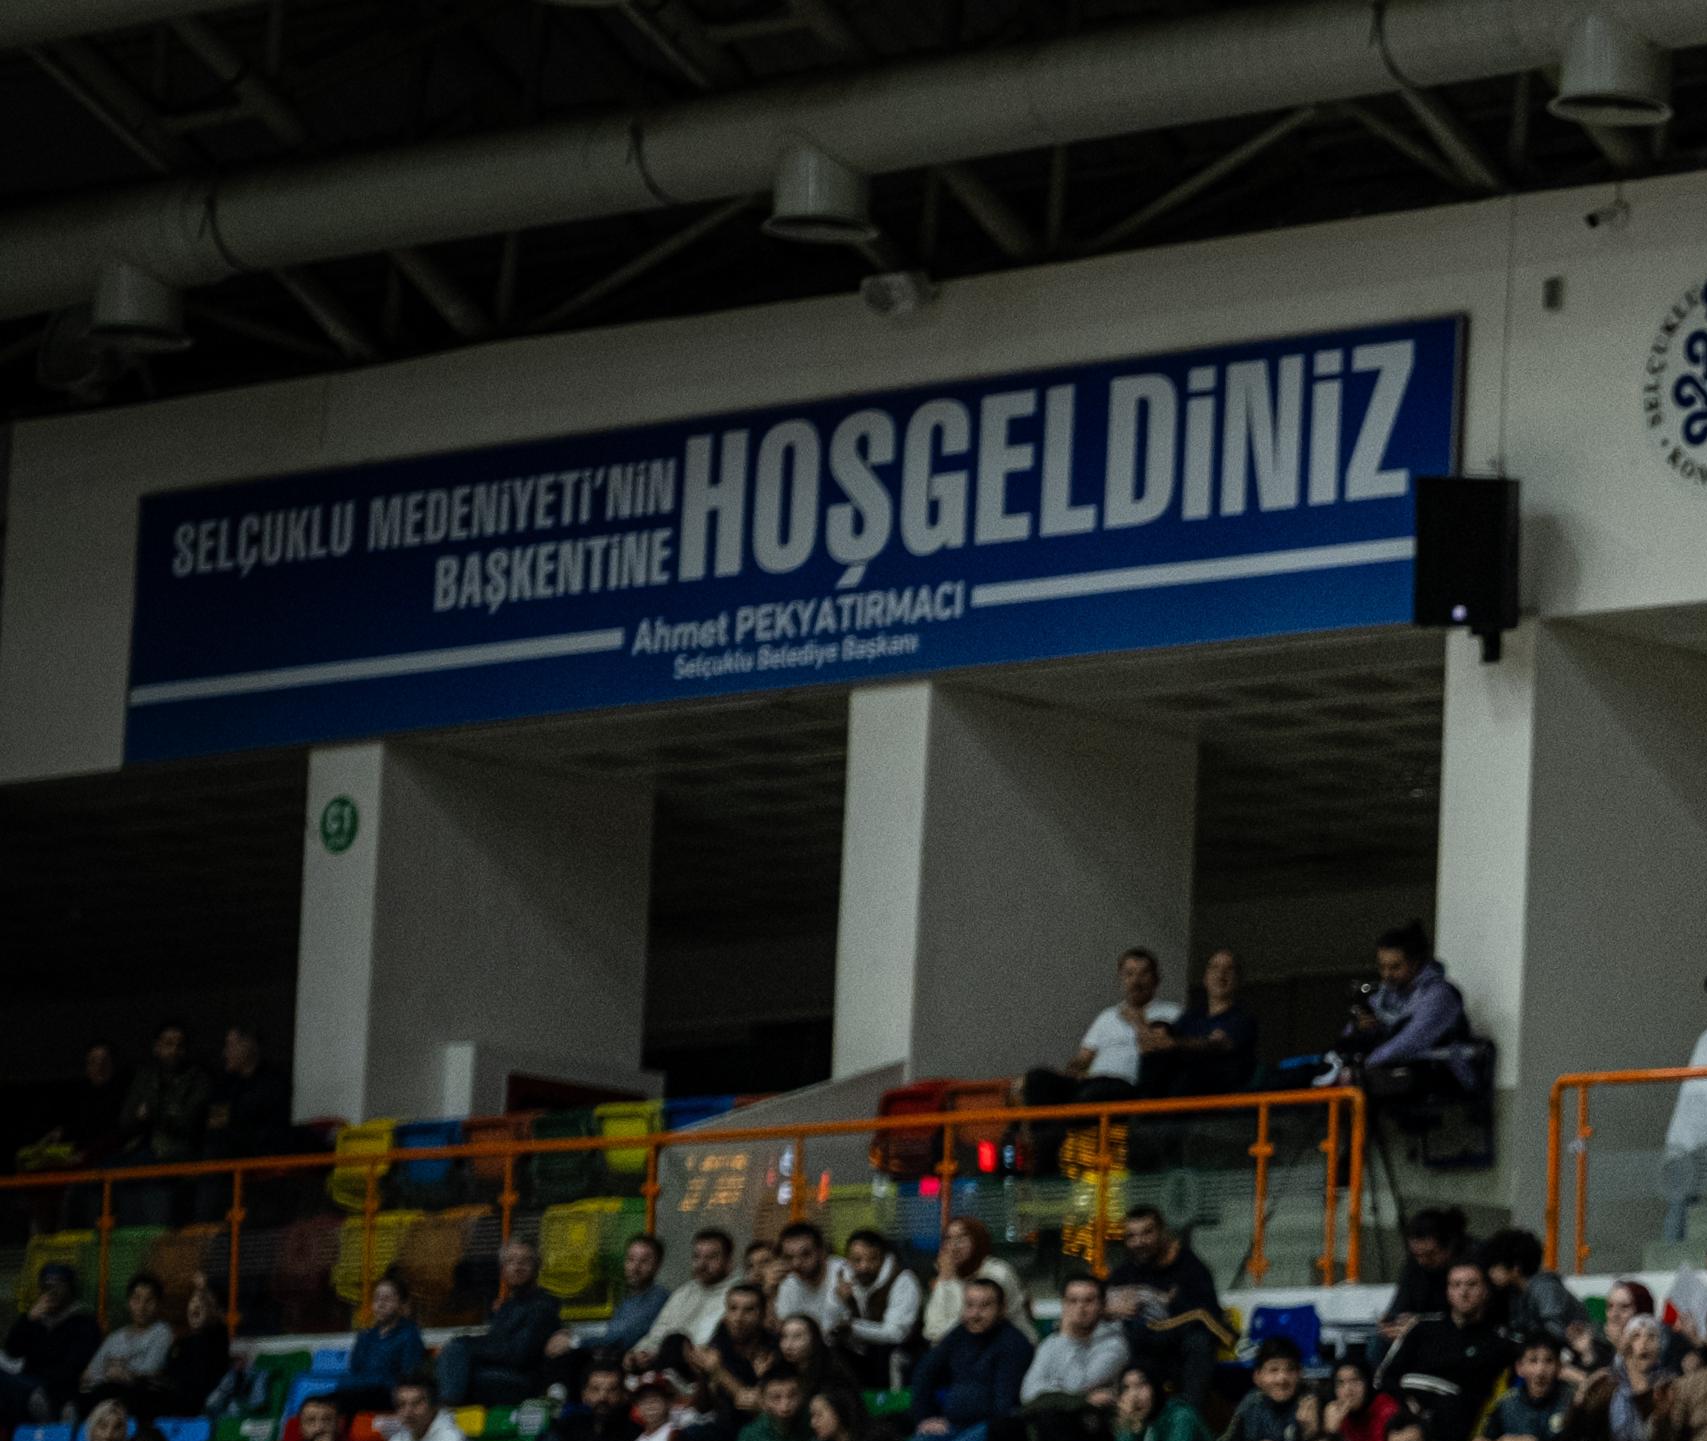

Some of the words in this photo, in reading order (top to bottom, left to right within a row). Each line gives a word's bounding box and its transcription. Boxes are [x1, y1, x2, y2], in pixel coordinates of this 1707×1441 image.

[677, 340, 1417, 590] HOŞGELDİNİZ
[171, 500, 356, 579] SELÇUKLU
[432, 527, 674, 614] BAŞKENTİNE
[631, 610, 729, 656] Ahmet
[734, 579, 966, 644] PEKYATIRMACI
